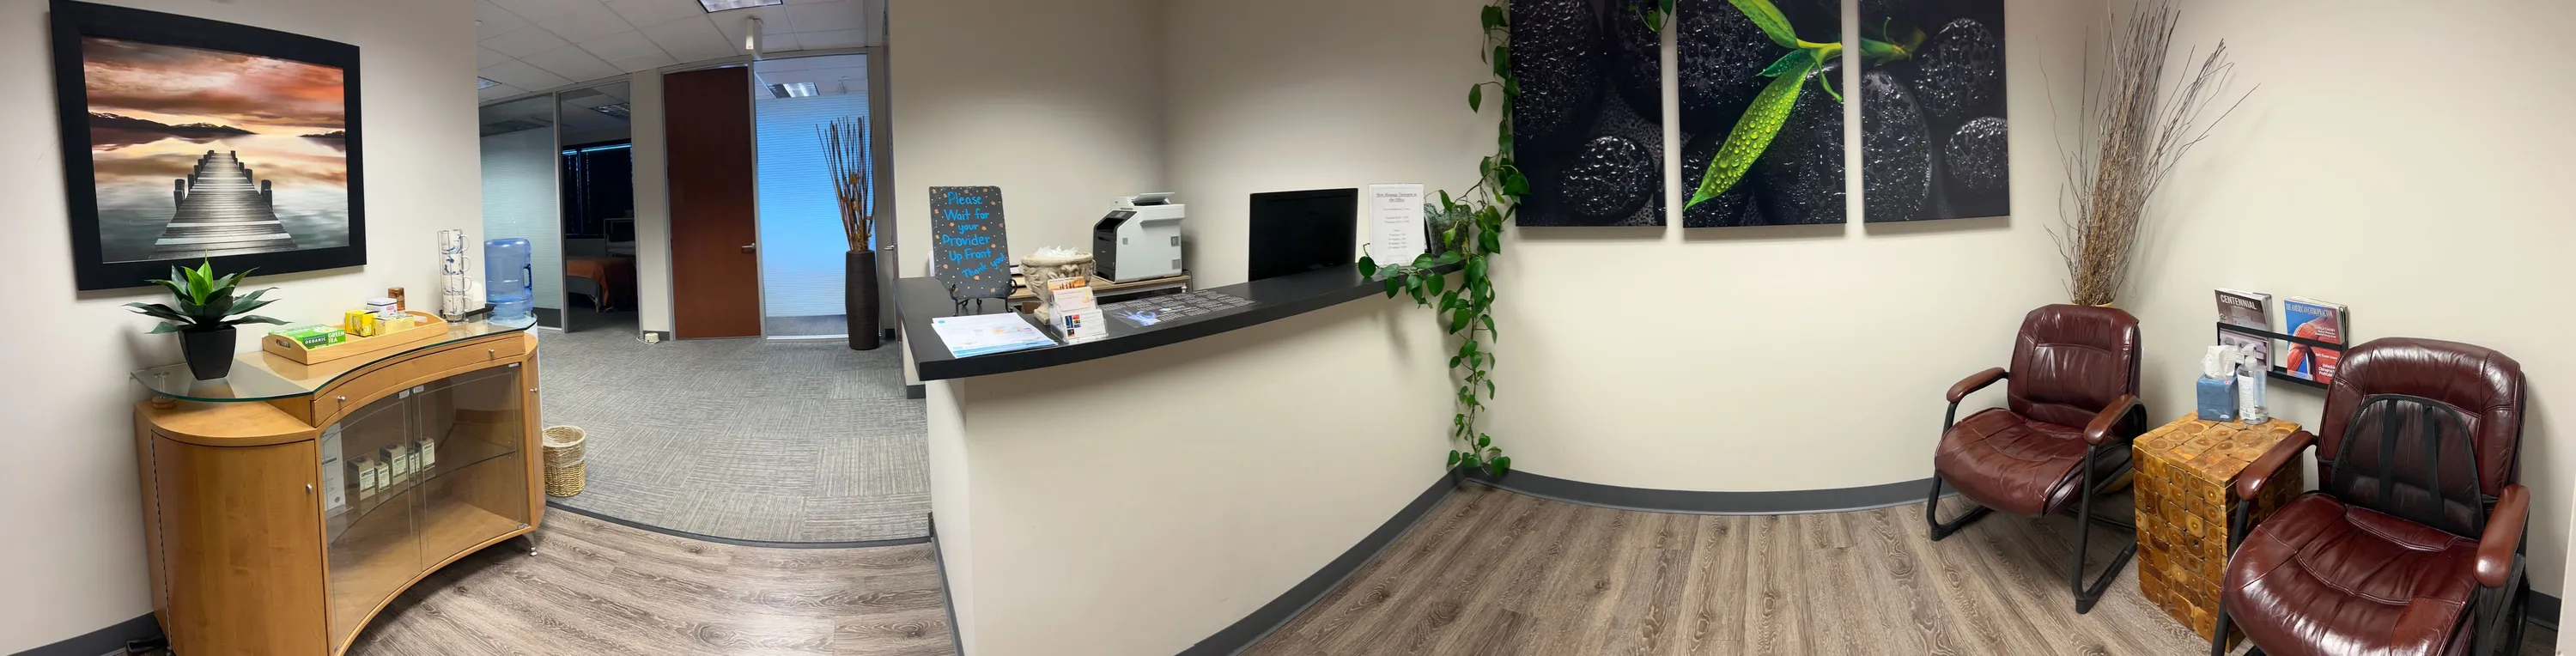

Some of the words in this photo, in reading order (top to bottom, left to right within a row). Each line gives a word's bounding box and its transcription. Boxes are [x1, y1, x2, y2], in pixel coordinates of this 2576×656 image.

[947, 191, 982, 205] Please
[943, 208, 970, 221] Wait
[975, 208, 990, 219] for
[957, 223, 979, 234] your
[942, 234, 991, 246] Provider
[949, 250, 962, 264] Up
[964, 247, 992, 260] Front
[962, 263, 987, 278] Thank
[990, 252, 1005, 270] you!
[2220, 294, 2257, 310] CENTENNIAL
[2292, 304, 2308, 313] AMERICAN
[2307, 307, 2334, 319] CHIROPRACTOR
